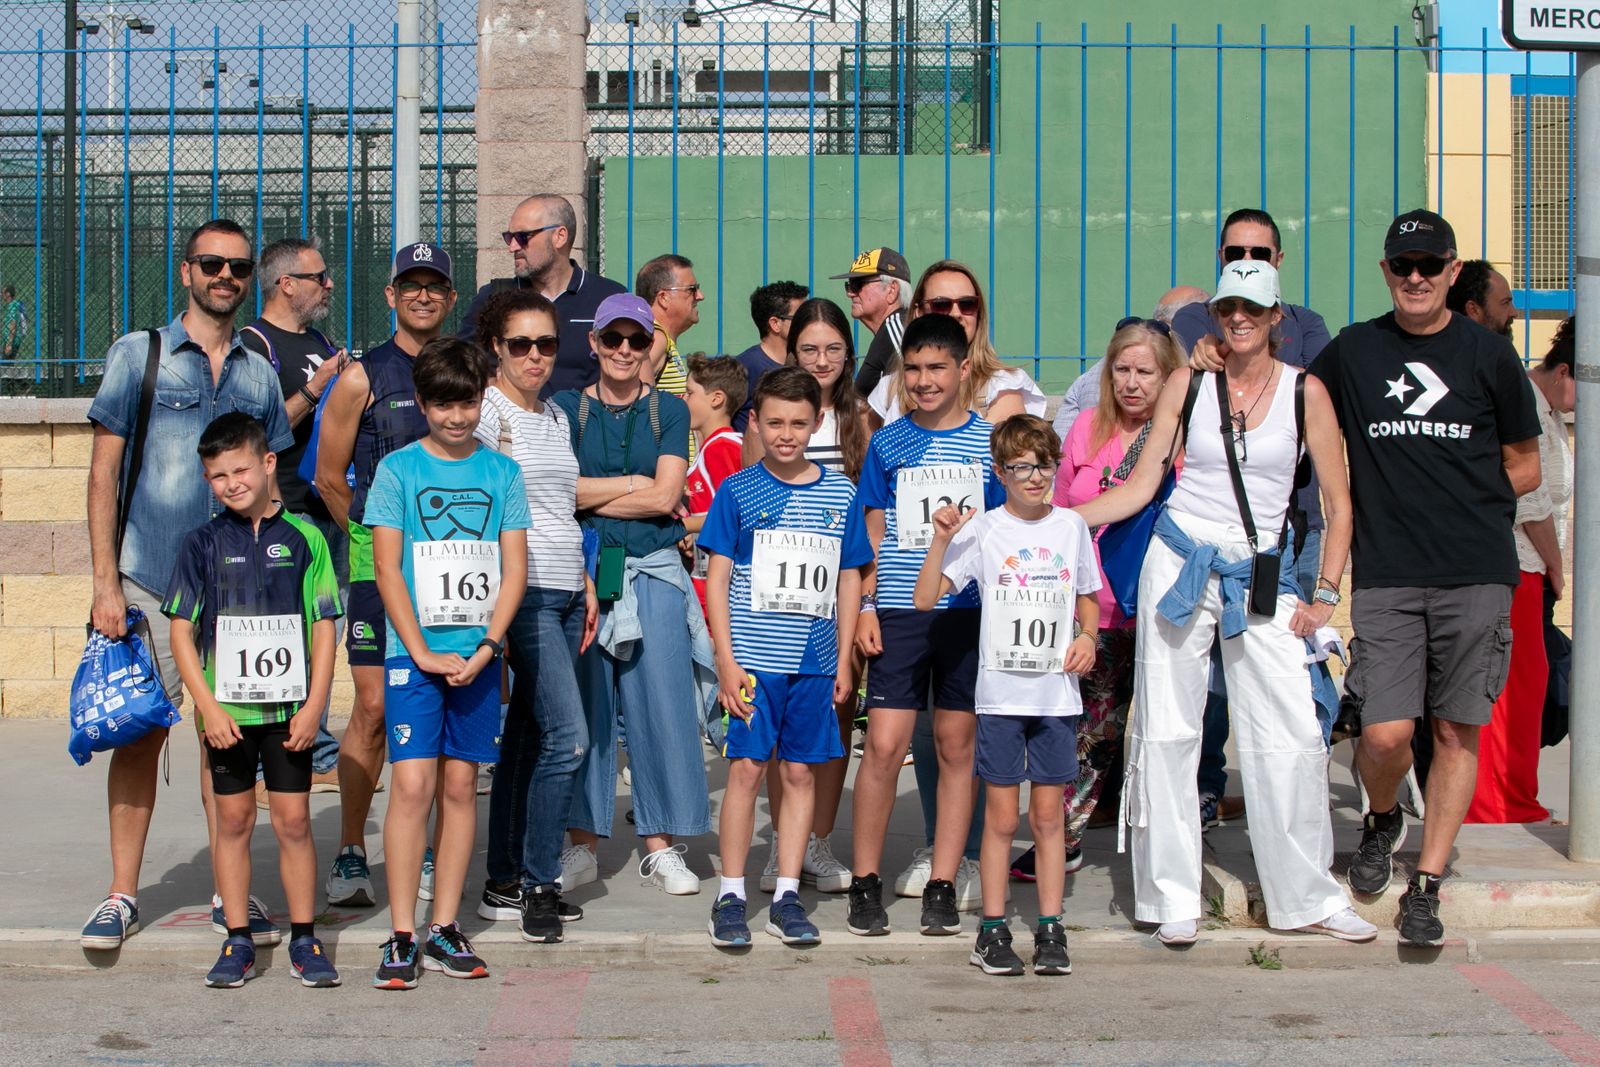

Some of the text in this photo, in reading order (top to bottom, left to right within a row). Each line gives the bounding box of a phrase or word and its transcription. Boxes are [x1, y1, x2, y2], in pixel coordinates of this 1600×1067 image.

[1530, 8, 1600, 29] MERC
[1368, 420, 1472, 438] CONVERSE
[921, 467, 977, 481] MILLA
[441, 543, 494, 556] MILLA
[781, 533, 836, 551] MILLA
[438, 571, 490, 601] 163
[775, 561, 828, 593] 110
[1015, 589, 1066, 605] MILLA
[239, 618, 296, 631] MILLA
[1010, 618, 1058, 648] 101
[235, 647, 292, 678] 169
